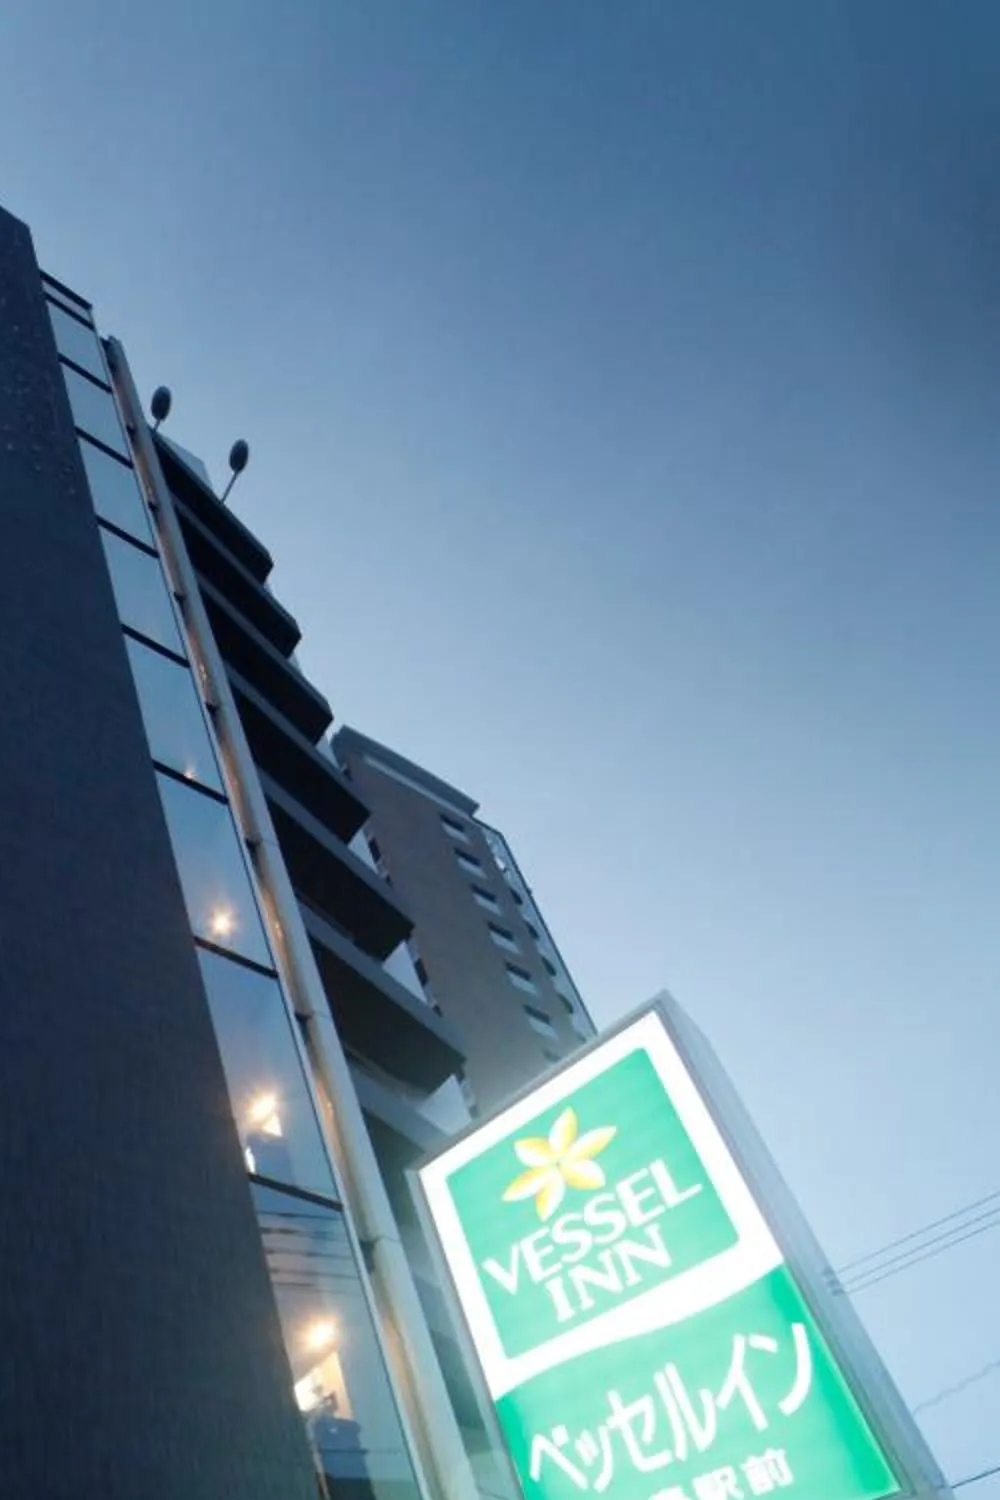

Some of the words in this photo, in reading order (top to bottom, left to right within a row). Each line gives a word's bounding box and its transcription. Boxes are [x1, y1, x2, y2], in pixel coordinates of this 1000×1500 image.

[481, 1158, 702, 1295] VESSEL
[548, 1223, 673, 1323] INN
[528, 1322, 813, 1492] ベッセルイン
